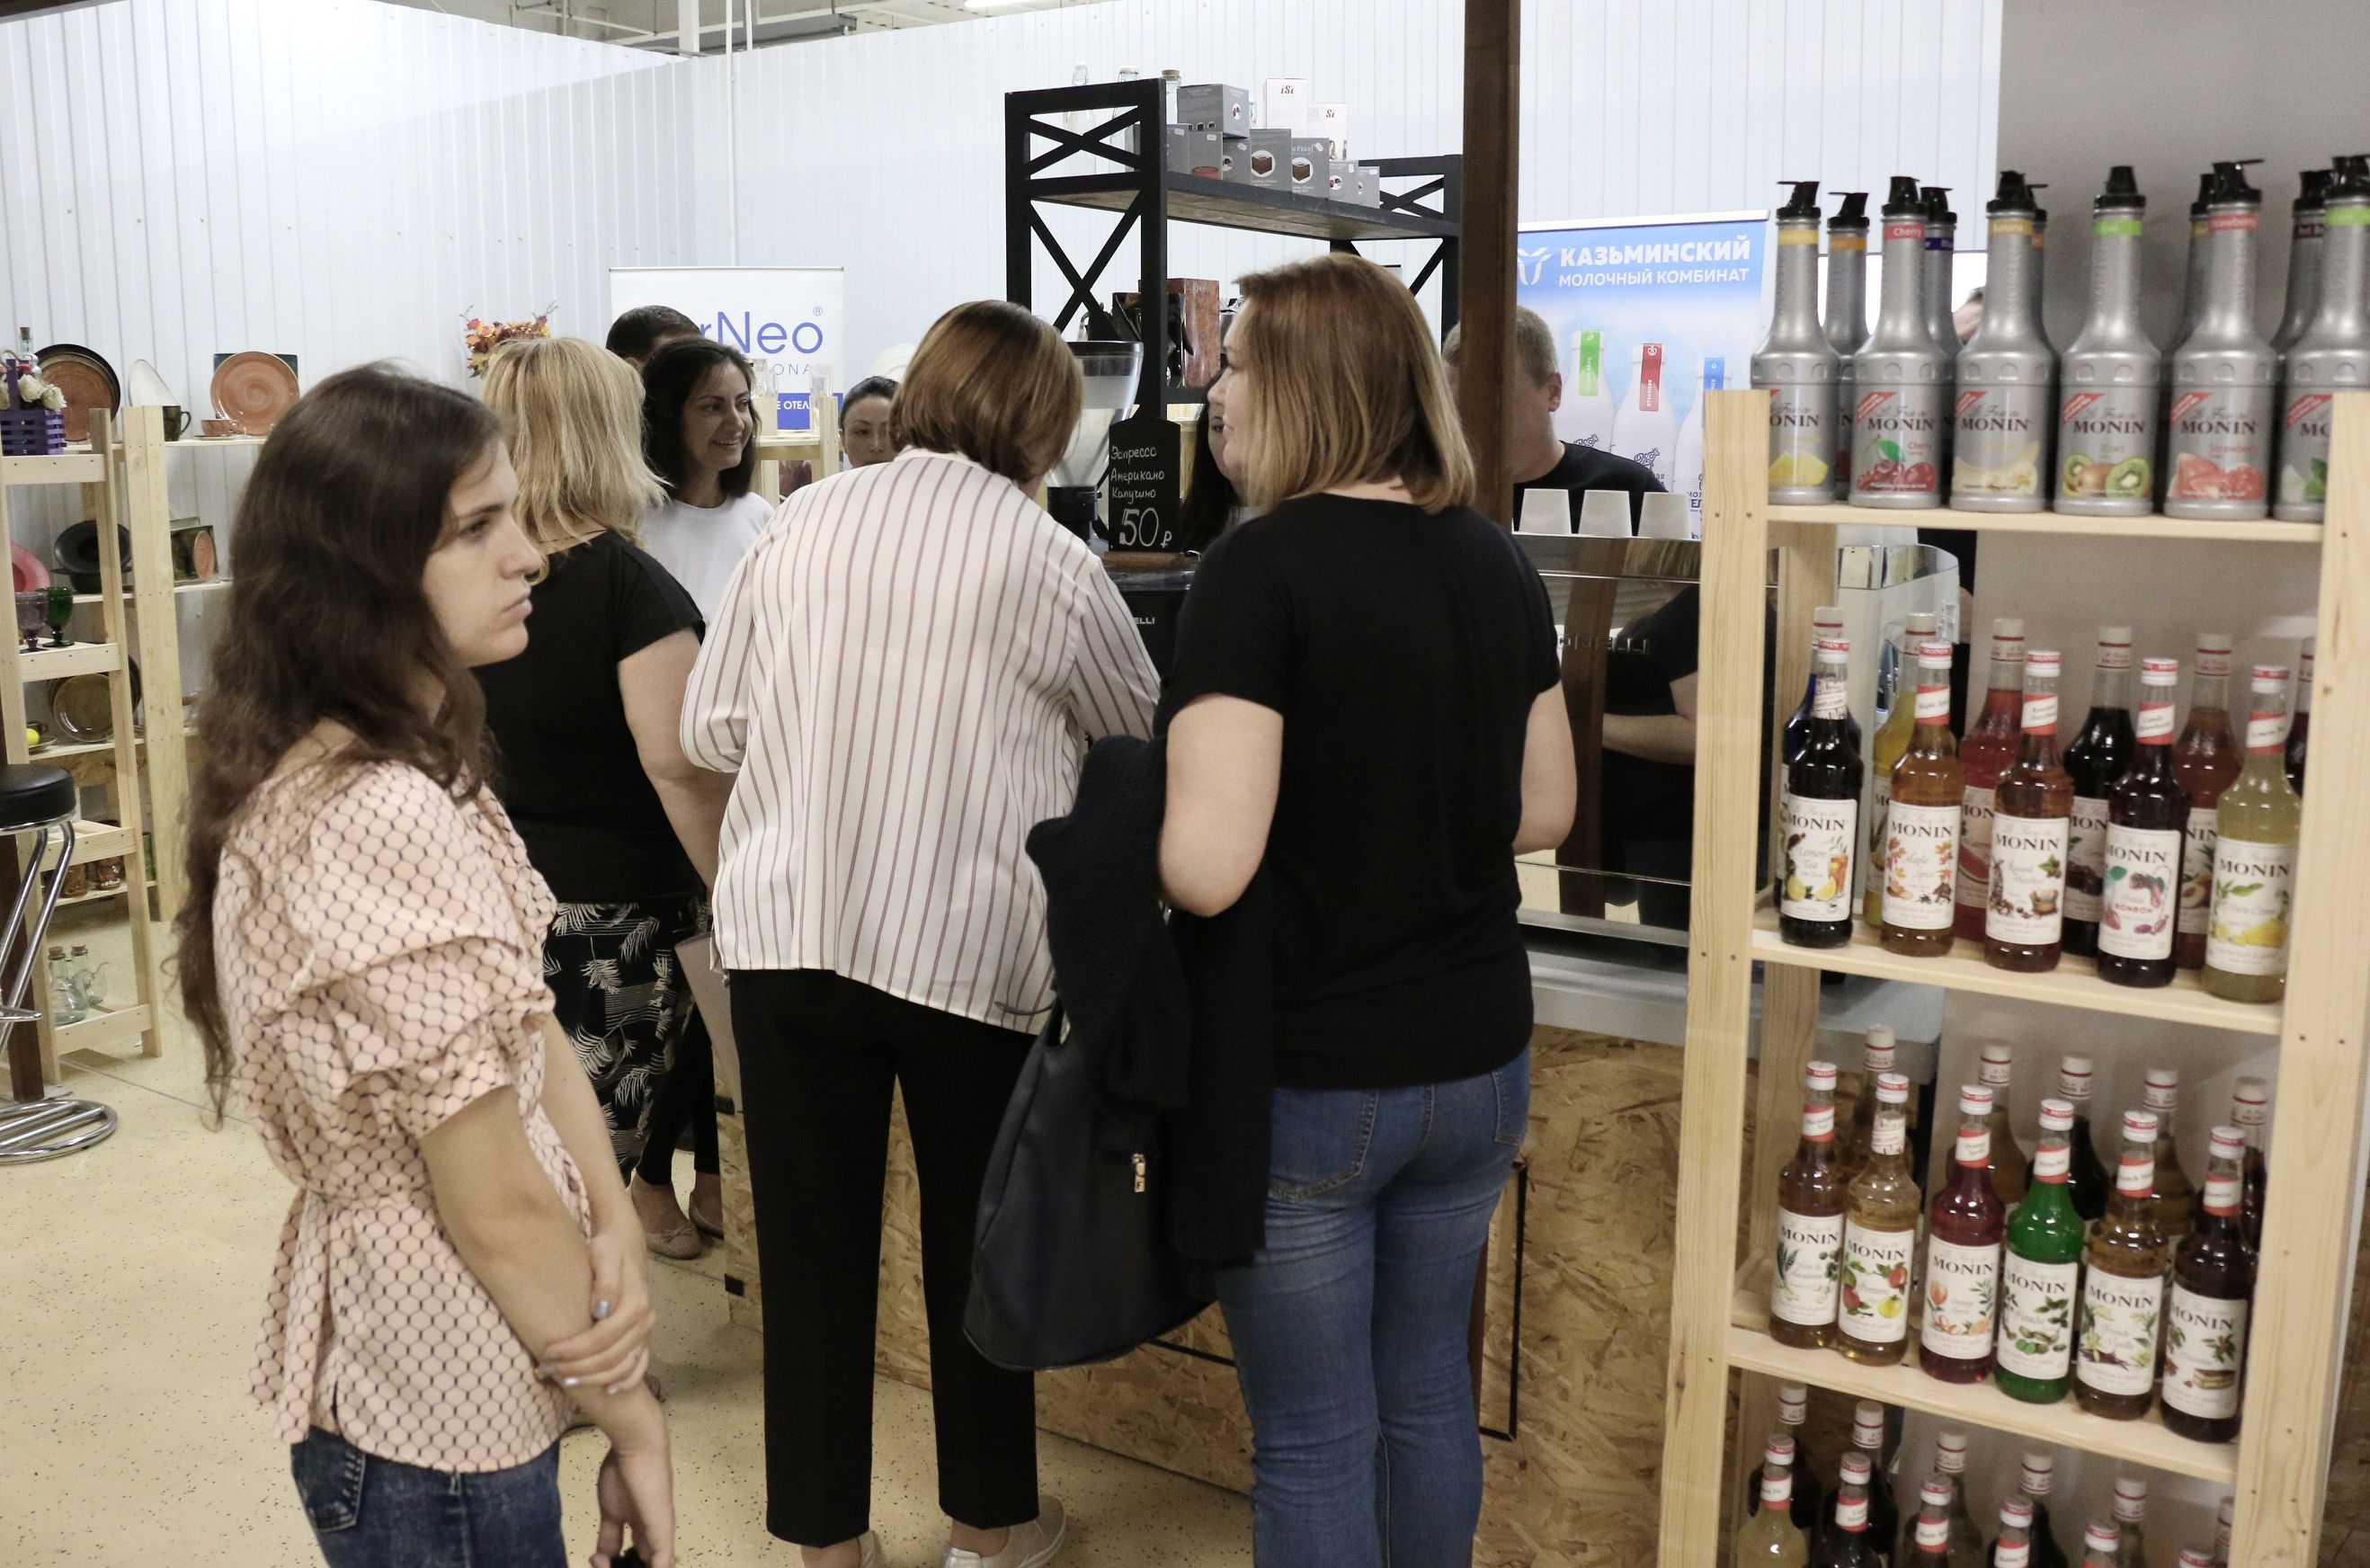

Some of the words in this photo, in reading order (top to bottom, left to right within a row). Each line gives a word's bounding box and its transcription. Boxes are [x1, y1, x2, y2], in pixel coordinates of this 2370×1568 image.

[1893, 227, 1923, 237] Cherry
[1560, 235, 1751, 267] КАЗЬМИНСКИЙ
[1559, 269, 1653, 287] МОЛОЧНЫЙ
[1657, 268, 1750, 285] КОМБИНАТ
[700, 311, 824, 354] rNeo
[783, 401, 810, 410] ОТЕЛ
[1769, 414, 1820, 427] ONIN
[1867, 417, 1935, 431] MONIN
[1962, 417, 2029, 432] MONIN
[2073, 420, 2145, 434] MONIN
[2181, 420, 2258, 435] MONIN
[1110, 446, 1157, 464] Эспрессо
[1110, 468, 1165, 485] Американо
[1111, 486, 1157, 504] Капучино
[1118, 507, 1160, 548] 50
[1134, 617, 1155, 625] ELLI
[1790, 815, 1846, 831] MONIN
[1892, 820, 1953, 838] MONIN
[1997, 833, 2060, 851] MONIN
[2186, 827, 2217, 842] NIN
[2221, 859, 2290, 878] MONIN
[1781, 1225, 1839, 1245] MONIN
[1848, 1240, 1906, 1260] MONIN
[1934, 1256, 1993, 1275] MONIN
[2006, 1270, 2066, 1293] MONIN
[2089, 1284, 2154, 1308] MONIN
[2172, 1306, 2233, 1330] MONIN
